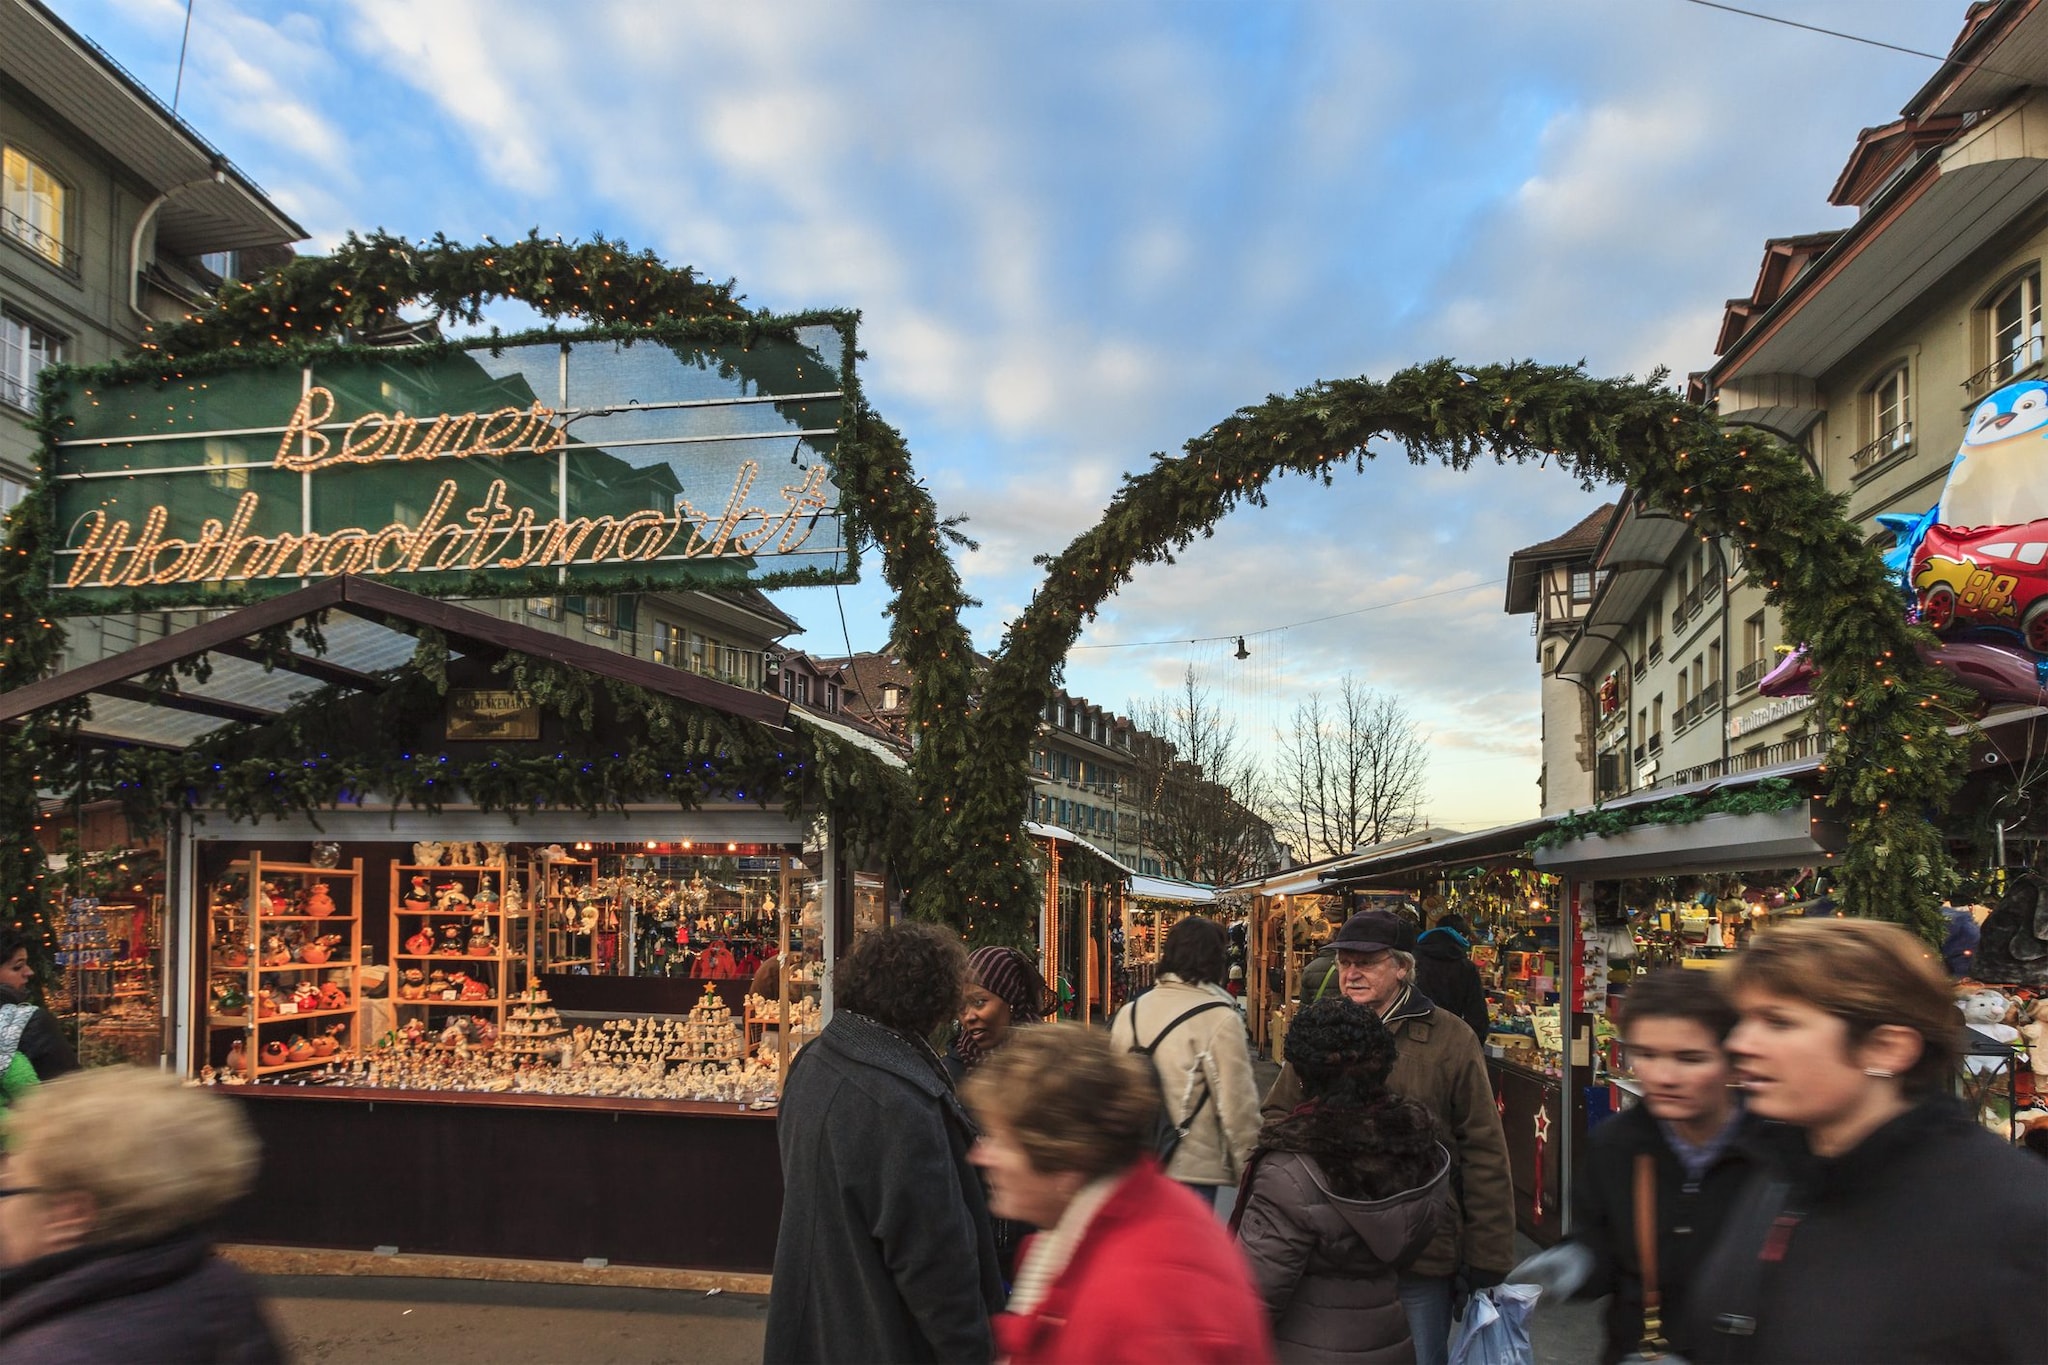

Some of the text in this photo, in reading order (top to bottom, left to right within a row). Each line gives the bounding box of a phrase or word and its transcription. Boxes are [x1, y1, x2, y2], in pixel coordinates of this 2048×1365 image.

[272, 385, 565, 472] Berner
[66, 459, 828, 589] Weihnachtsmarkt
[1957, 568, 2019, 614] 88
